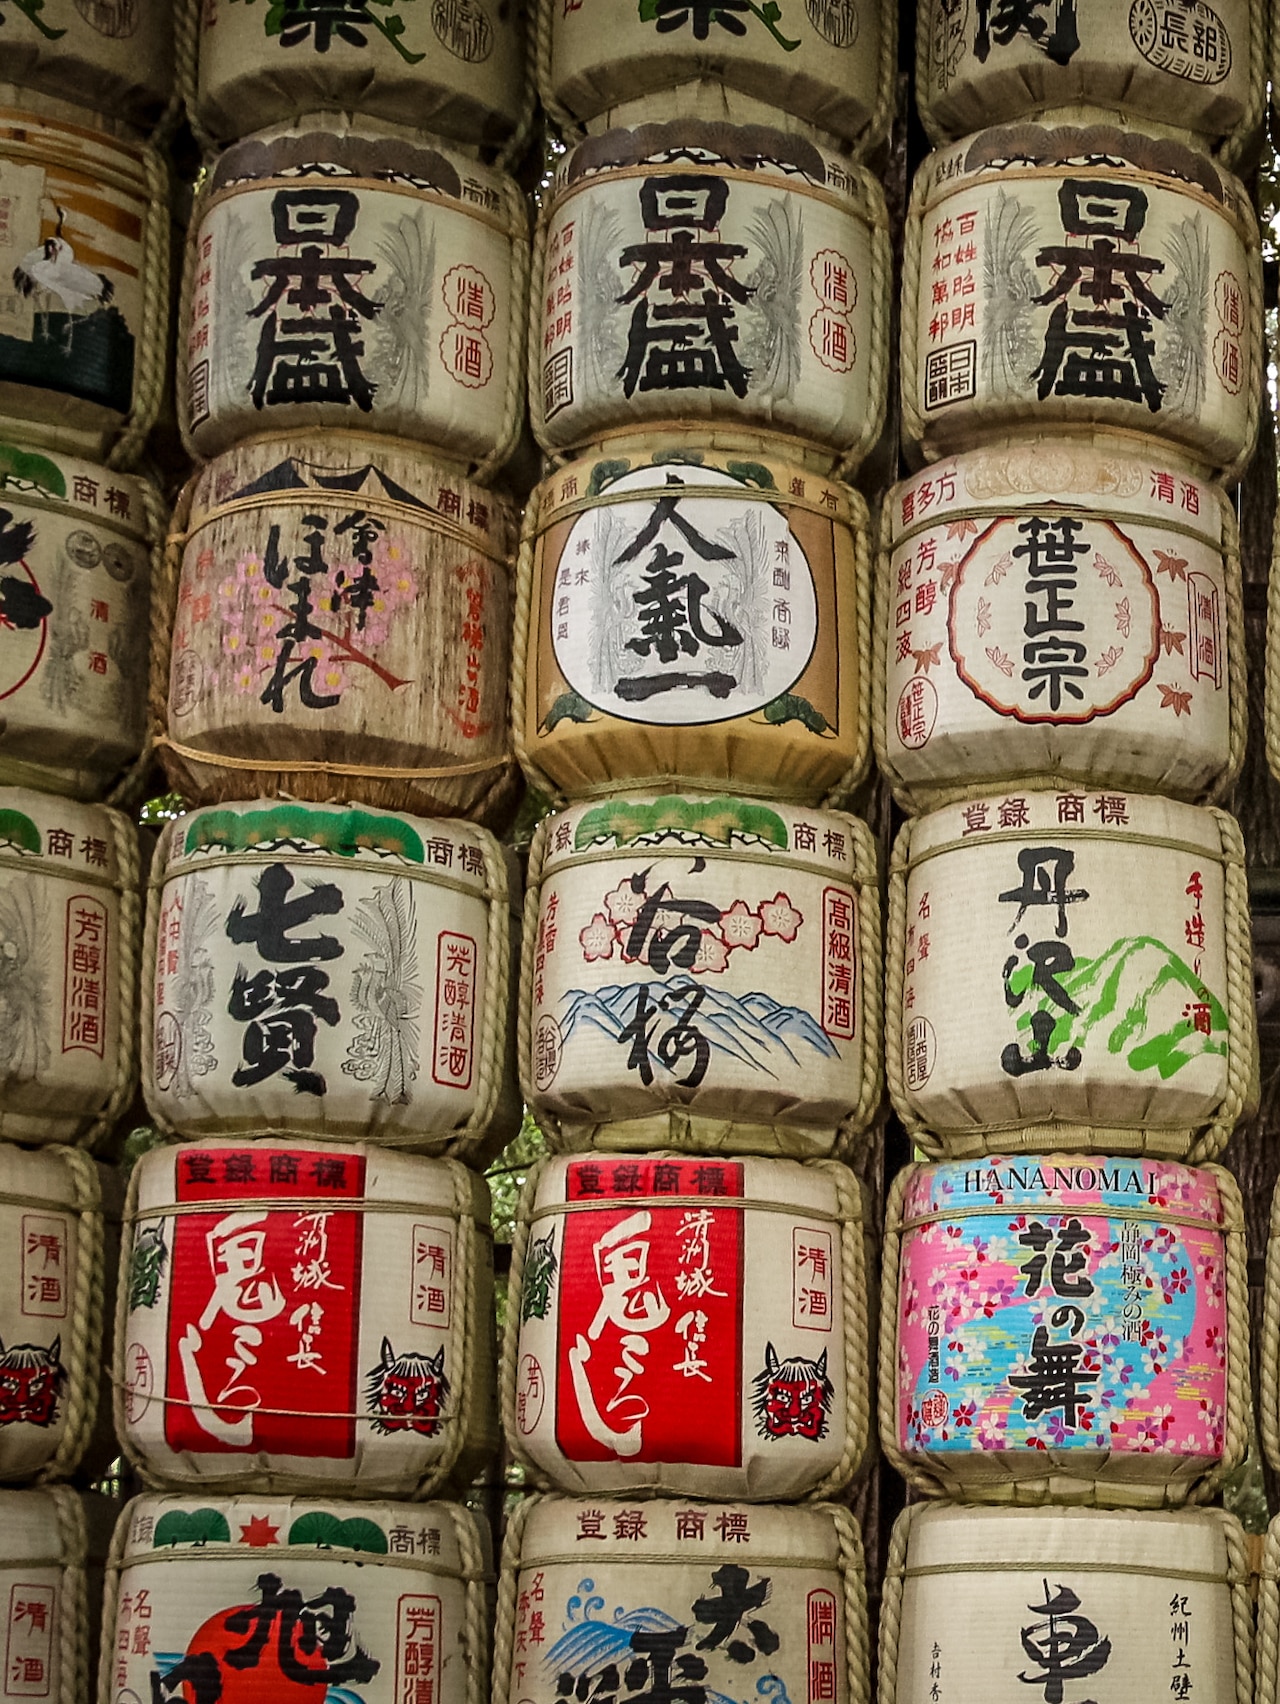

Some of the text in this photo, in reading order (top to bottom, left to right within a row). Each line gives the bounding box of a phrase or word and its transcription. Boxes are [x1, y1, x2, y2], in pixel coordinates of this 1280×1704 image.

[246, 189, 384, 413] 日本盛
[616, 175, 757, 401] 日本盛
[927, 217, 955, 344] 協和萬邦
[951, 210, 979, 332] 百姓昭明
[1031, 178, 1172, 413] 日本盛
[455, 278, 485, 380] 清酒
[823, 261, 848, 363] 清酒
[72, 474, 131, 521] 商標
[901, 472, 958, 526] 喜多方
[1150, 471, 1200, 516] 清酒
[916, 538, 938, 617] 芳醇
[1012, 516, 1091, 711] 笹正宗
[90, 599, 109, 676] 清酒
[911, 681, 926, 742] 笹正宗
[47, 829, 108, 868] 商標
[427, 837, 483, 876] 商標
[792, 822, 847, 861] 商標
[71, 908, 103, 1044] 芳醇清酒
[225, 862, 345, 1097] 七賢
[998, 846, 1089, 1078] 丹沢山
[184, 1154, 348, 1190] 登録商標
[576, 1164, 728, 1196] 登録商標
[964, 1166, 1157, 1195] HANANOMAI
[27, 1233, 64, 1302] 清酒
[416, 1242, 446, 1313] 清酒
[797, 1244, 828, 1316] 清酒
[1120, 1222, 1144, 1343] 静岡極みの酒
[178, 1211, 287, 1447] 鬼ころし
[568, 1210, 671, 1456] 鬼ころし
[1007, 1218, 1102, 1428] 花の舞
[388, 1525, 441, 1557] 商標
[12, 1600, 49, 1683] 清酒
[929, 1642, 942, 1704] 吉村秀
